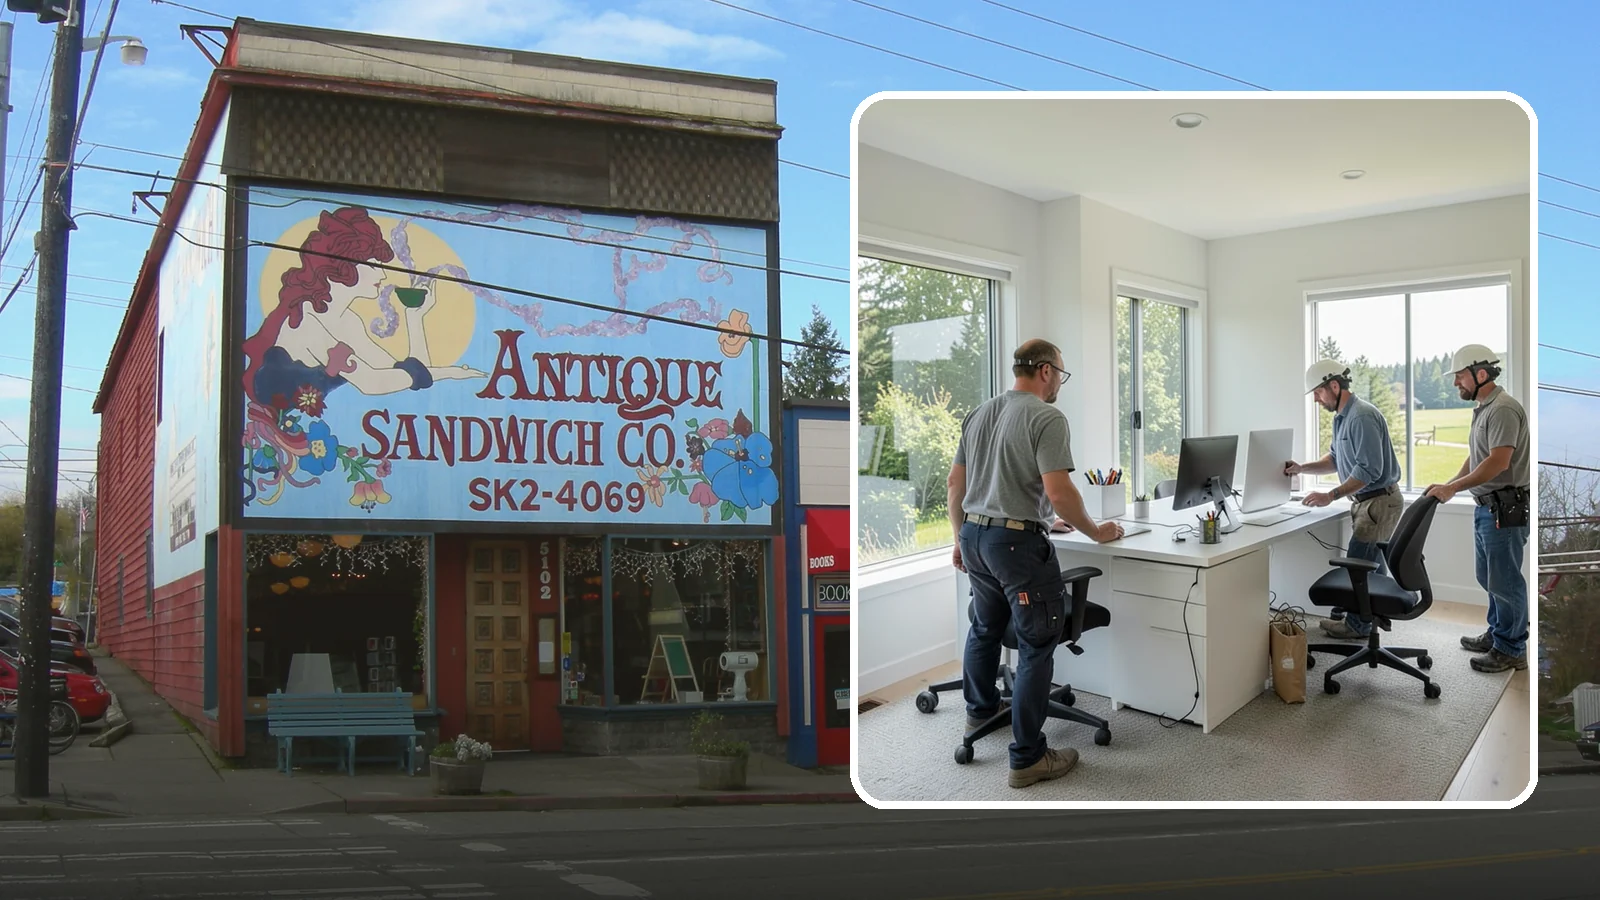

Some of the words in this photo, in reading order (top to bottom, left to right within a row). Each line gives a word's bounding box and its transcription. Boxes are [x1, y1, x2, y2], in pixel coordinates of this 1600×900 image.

[476, 329, 723, 420] ANTIQUE
[361, 408, 605, 468] SANDWICH
[617, 422, 685, 469] CO.
[468, 477, 646, 513] SK2-4069
[540, 541, 552, 600] 5102
[809, 555, 835, 569] BOOKS
